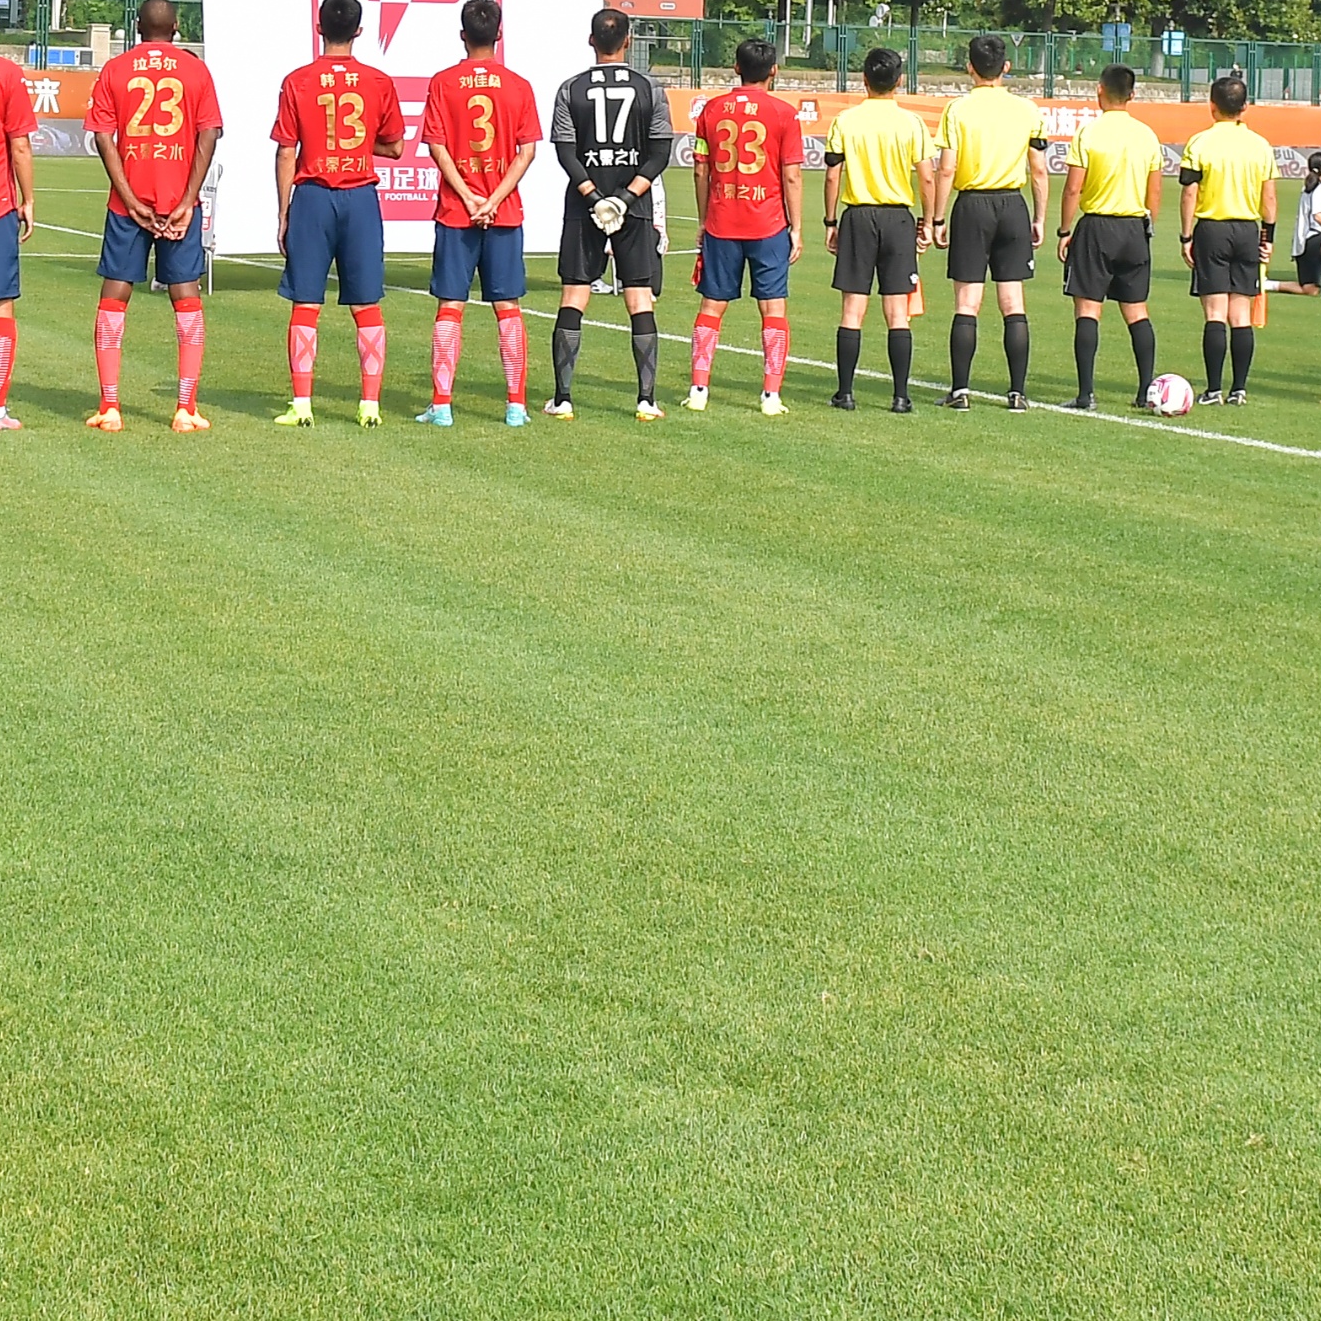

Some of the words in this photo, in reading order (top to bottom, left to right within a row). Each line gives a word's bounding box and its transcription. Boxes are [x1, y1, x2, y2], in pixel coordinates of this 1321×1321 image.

[133, 57, 177, 71] 拉乌尔
[126, 77, 184, 137] 23
[317, 92, 366, 150] 13
[467, 94, 495, 152] 3
[586, 87, 636, 143] 17
[715, 119, 767, 174] 33
[384, 193, 428, 201] FOOTBALL
